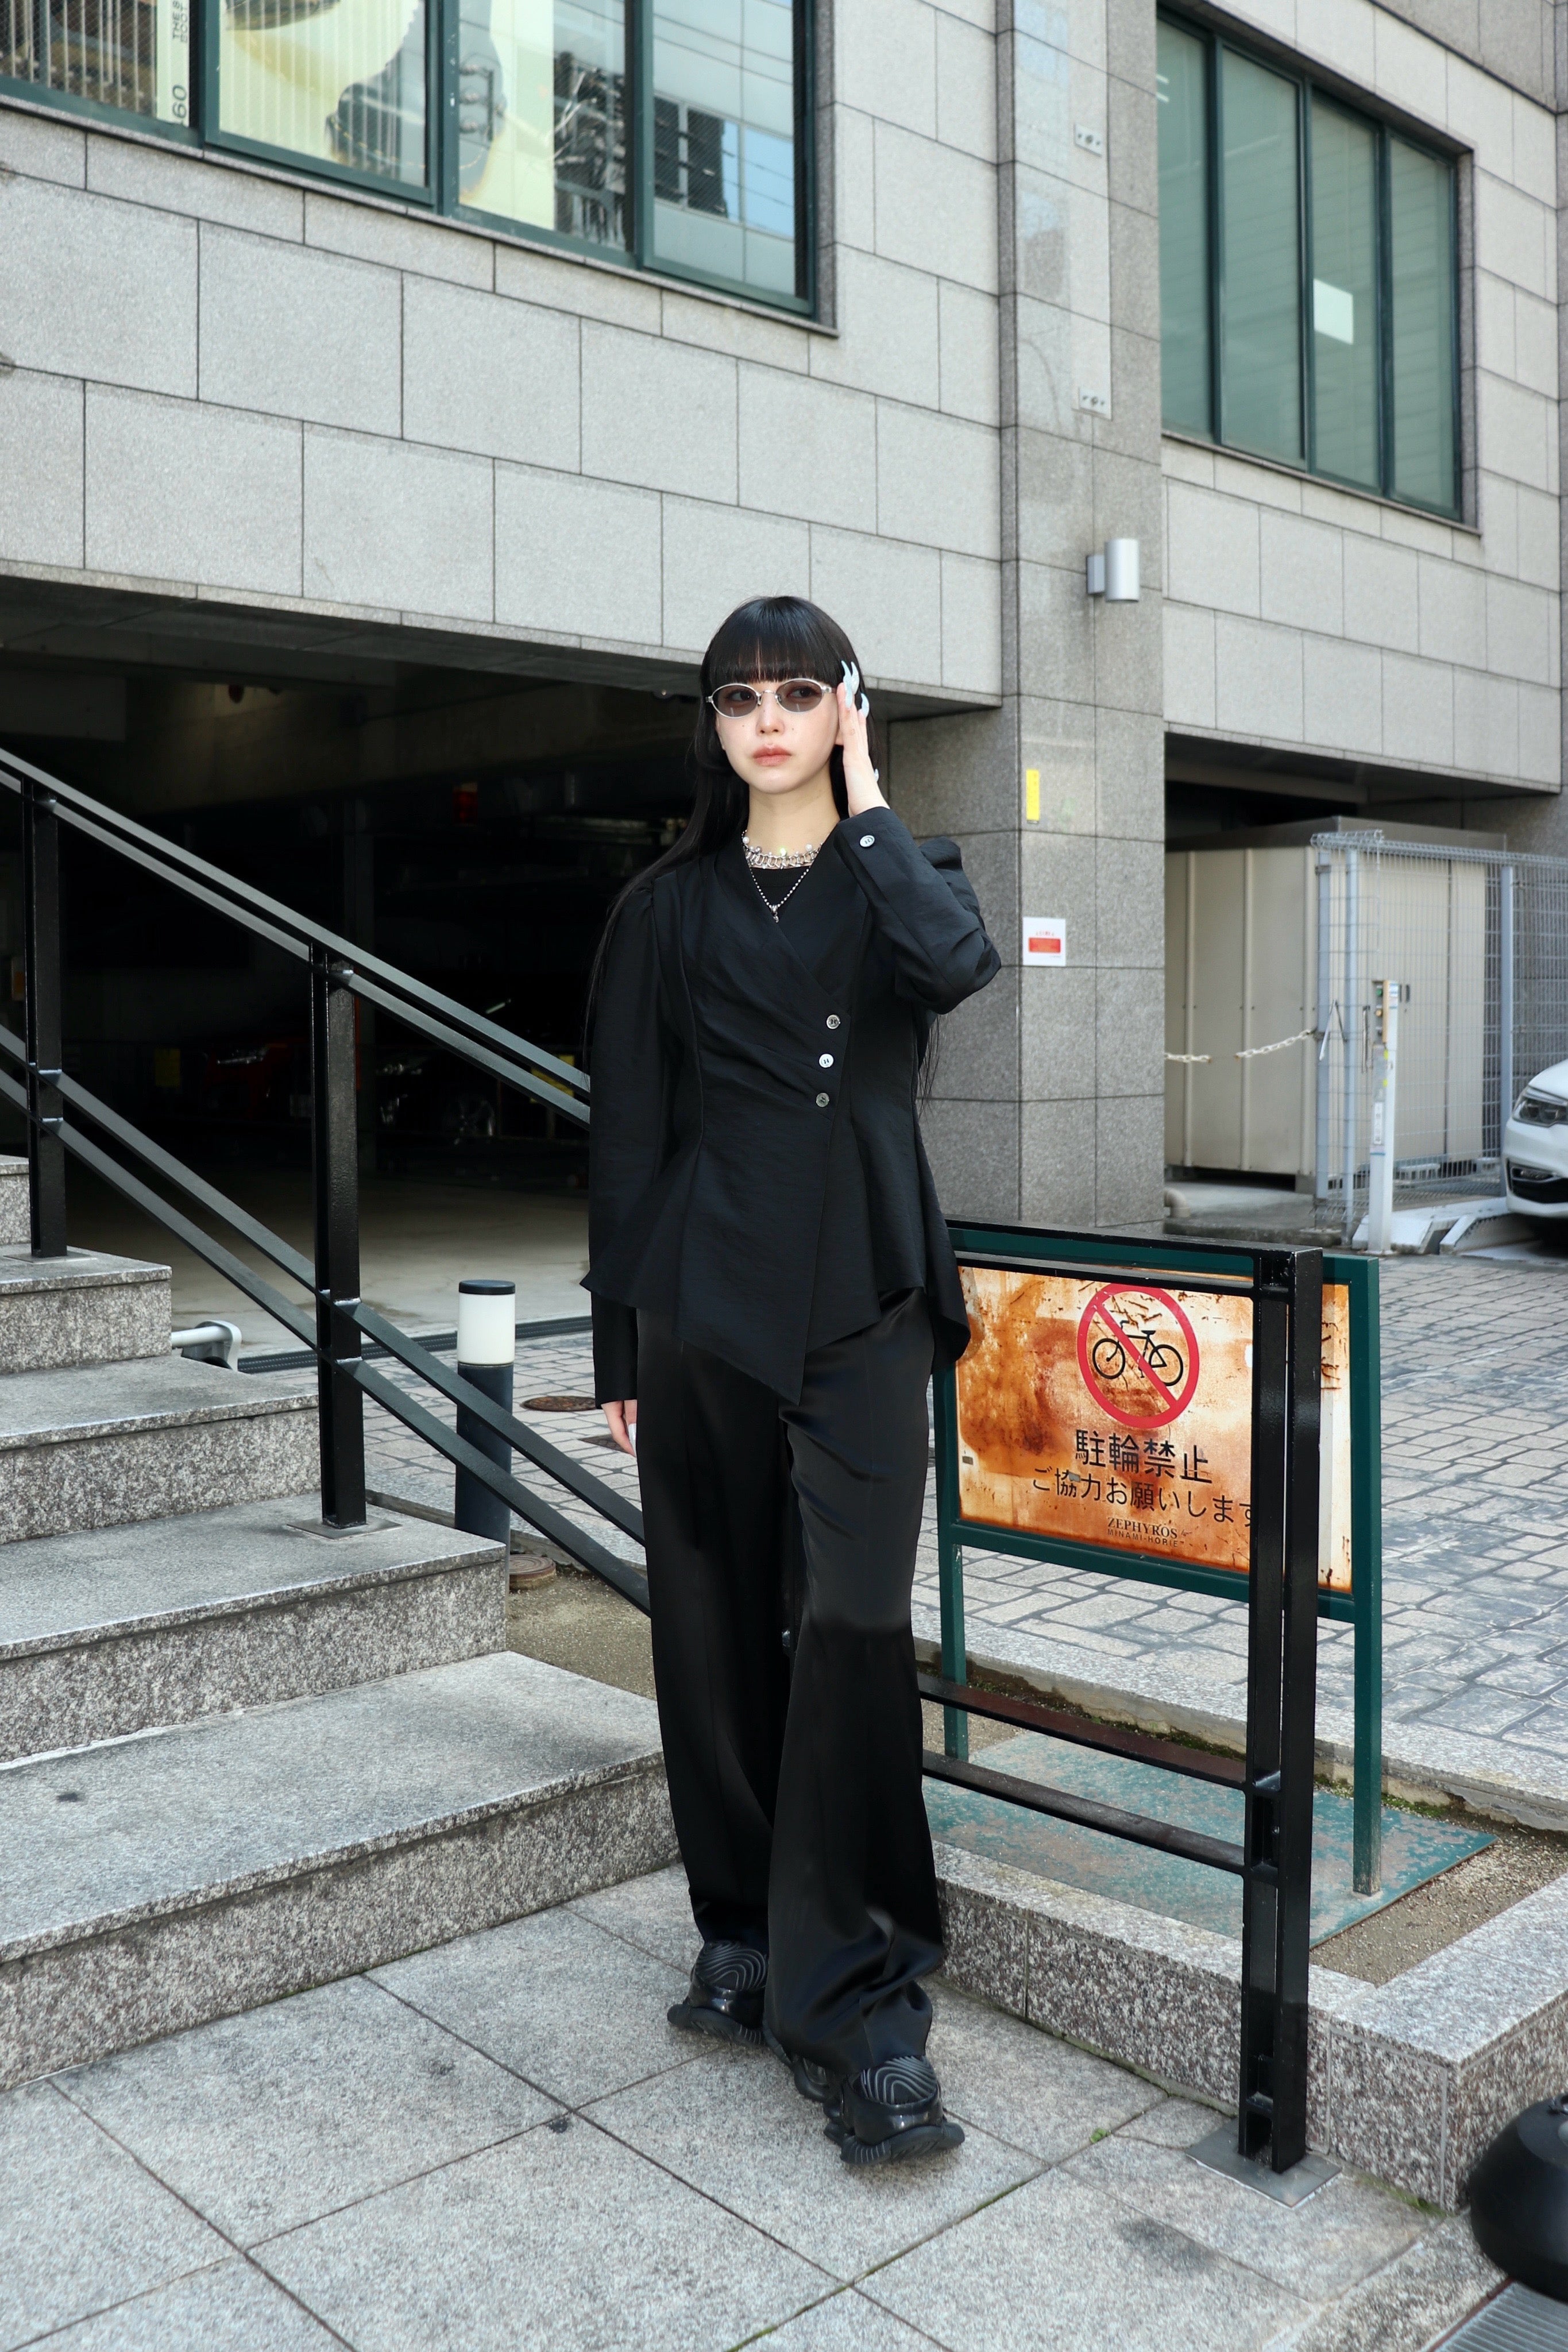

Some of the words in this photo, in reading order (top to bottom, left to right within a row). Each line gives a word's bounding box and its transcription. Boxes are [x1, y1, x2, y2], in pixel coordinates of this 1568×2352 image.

[1075, 1428, 1212, 1484] 駐輪禁止
[1107, 1517, 1178, 1539] ZEPHYROS
[1107, 1528, 1179, 1547] MINAMI-HORIE
